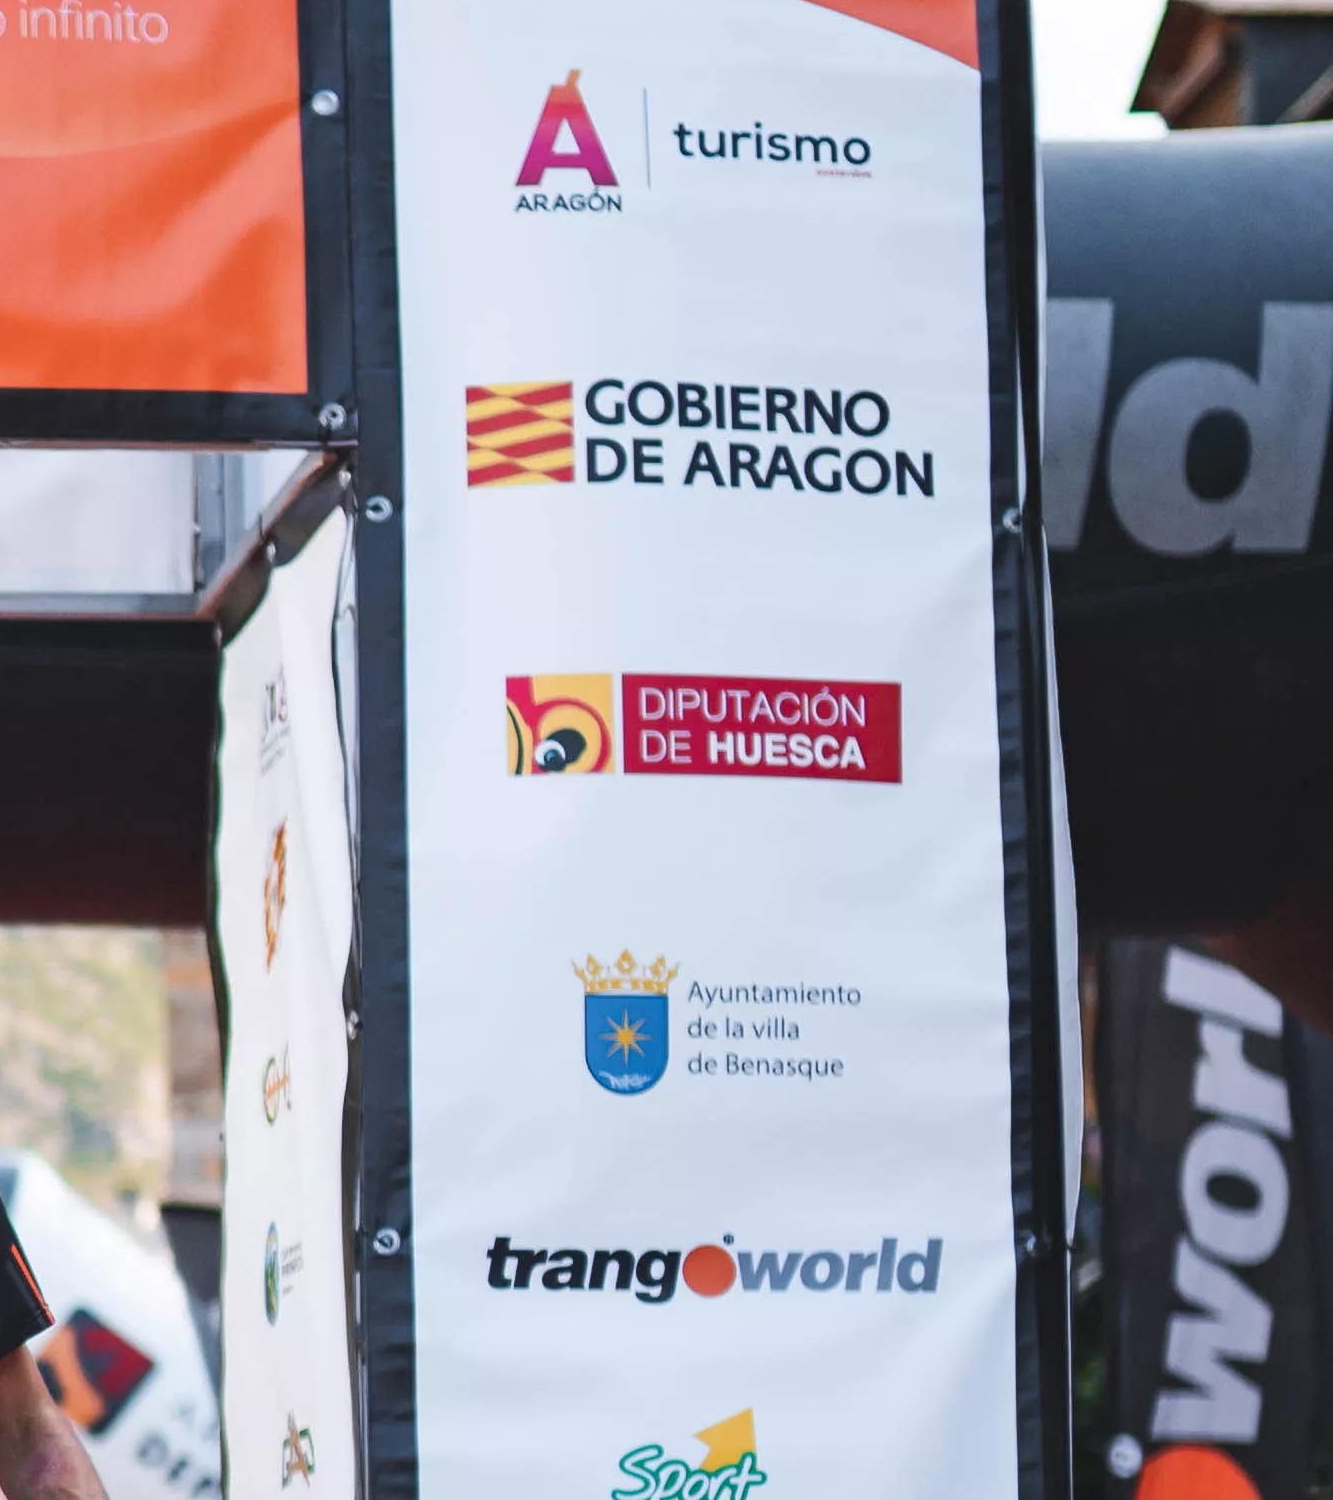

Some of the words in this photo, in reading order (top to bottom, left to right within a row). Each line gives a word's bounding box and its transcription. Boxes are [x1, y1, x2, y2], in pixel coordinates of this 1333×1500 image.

[673, 121, 872, 166] turismo
[514, 185, 623, 213] ARAGÓN
[585, 378, 891, 438] GOBIERNO
[585, 438, 664, 485] DE
[683, 442, 935, 498] ARAGON
[639, 686, 866, 729] DIPUTACIÓN
[639, 729, 691, 764] DE
[708, 731, 866, 770] HUESCA
[686, 981, 862, 1010] Ayuntamiento
[686, 1015, 718, 1040] de
[725, 1016, 745, 1040] la
[751, 1016, 801, 1042] villa
[686, 1052, 718, 1077] de
[725, 1054, 845, 1081] Benasque
